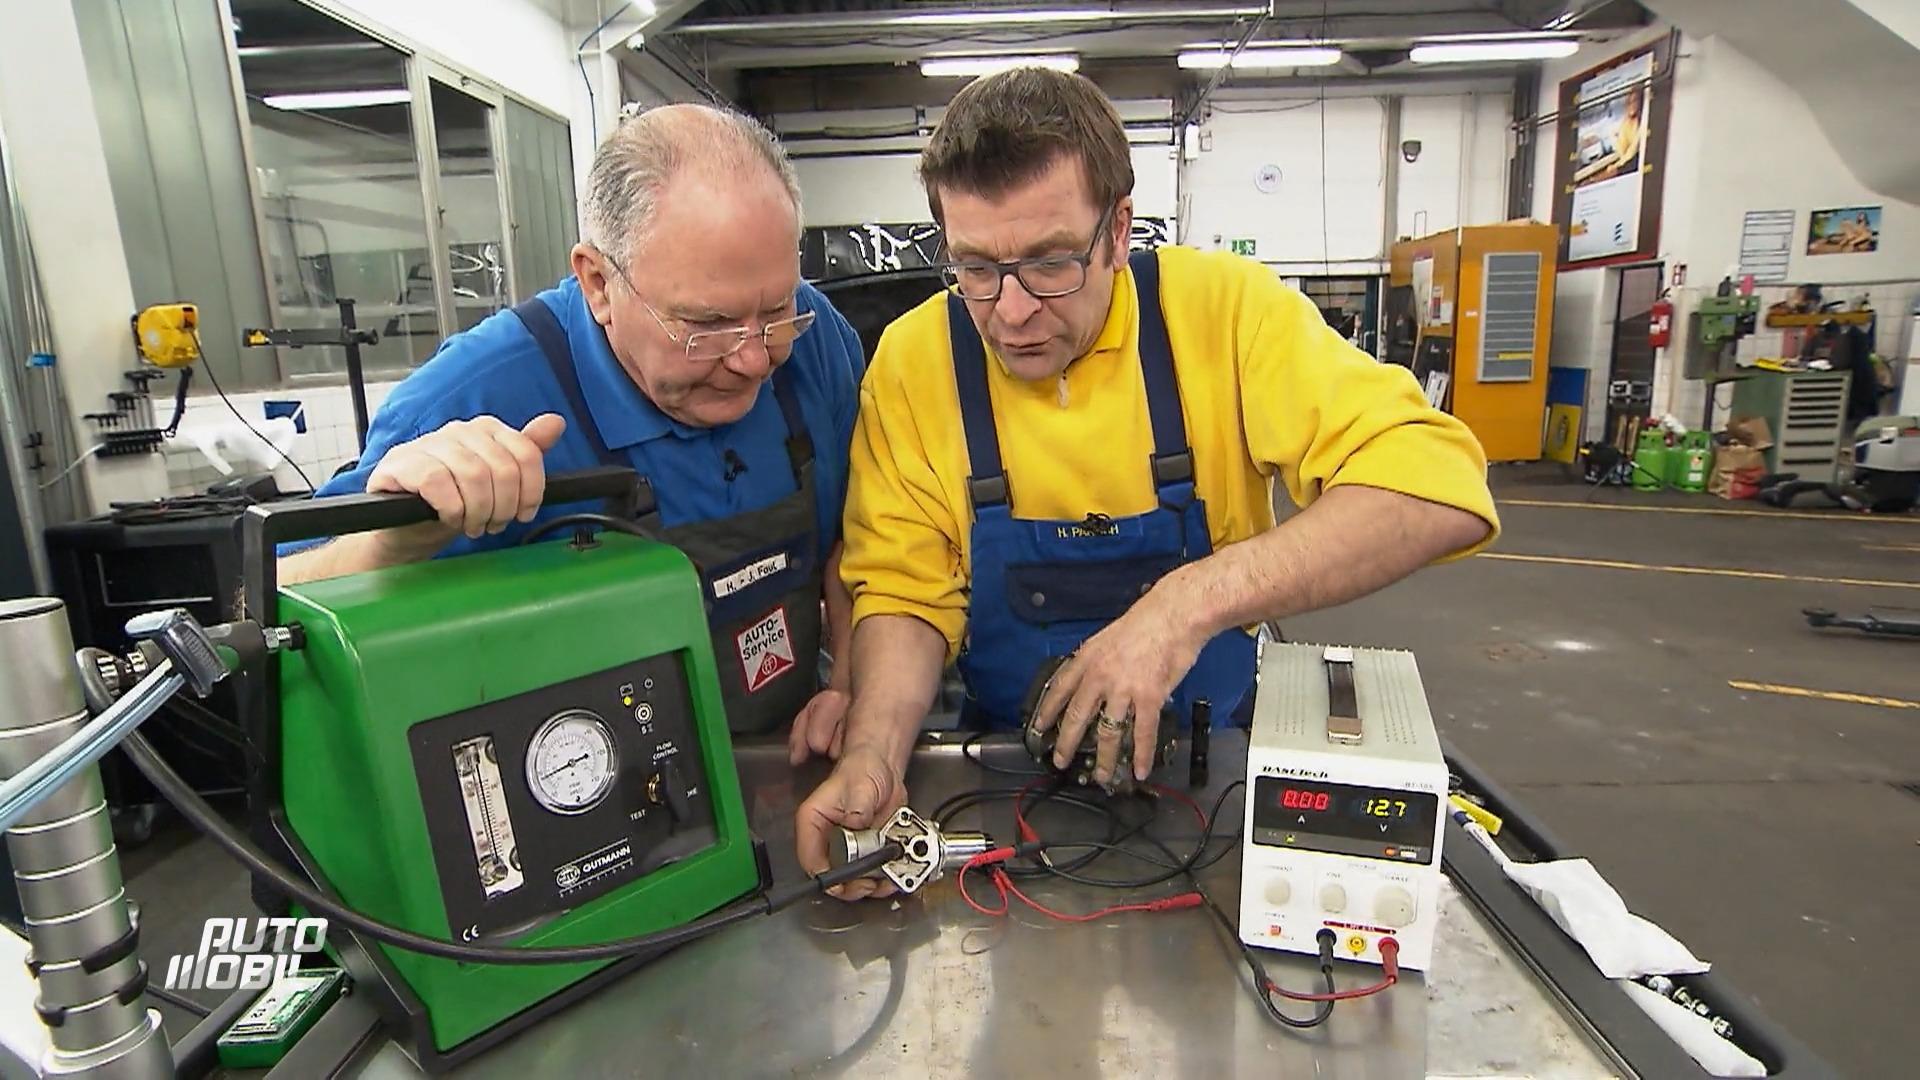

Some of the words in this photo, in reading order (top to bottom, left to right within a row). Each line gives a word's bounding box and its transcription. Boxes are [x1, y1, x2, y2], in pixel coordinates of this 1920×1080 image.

[745, 618, 779, 646] AUTO-
[742, 628, 784, 661] Service
[629, 808, 647, 821] TEST
[1297, 815, 1306, 824] A
[1379, 823, 1389, 833] V
[582, 845, 631, 873] GUTMANN
